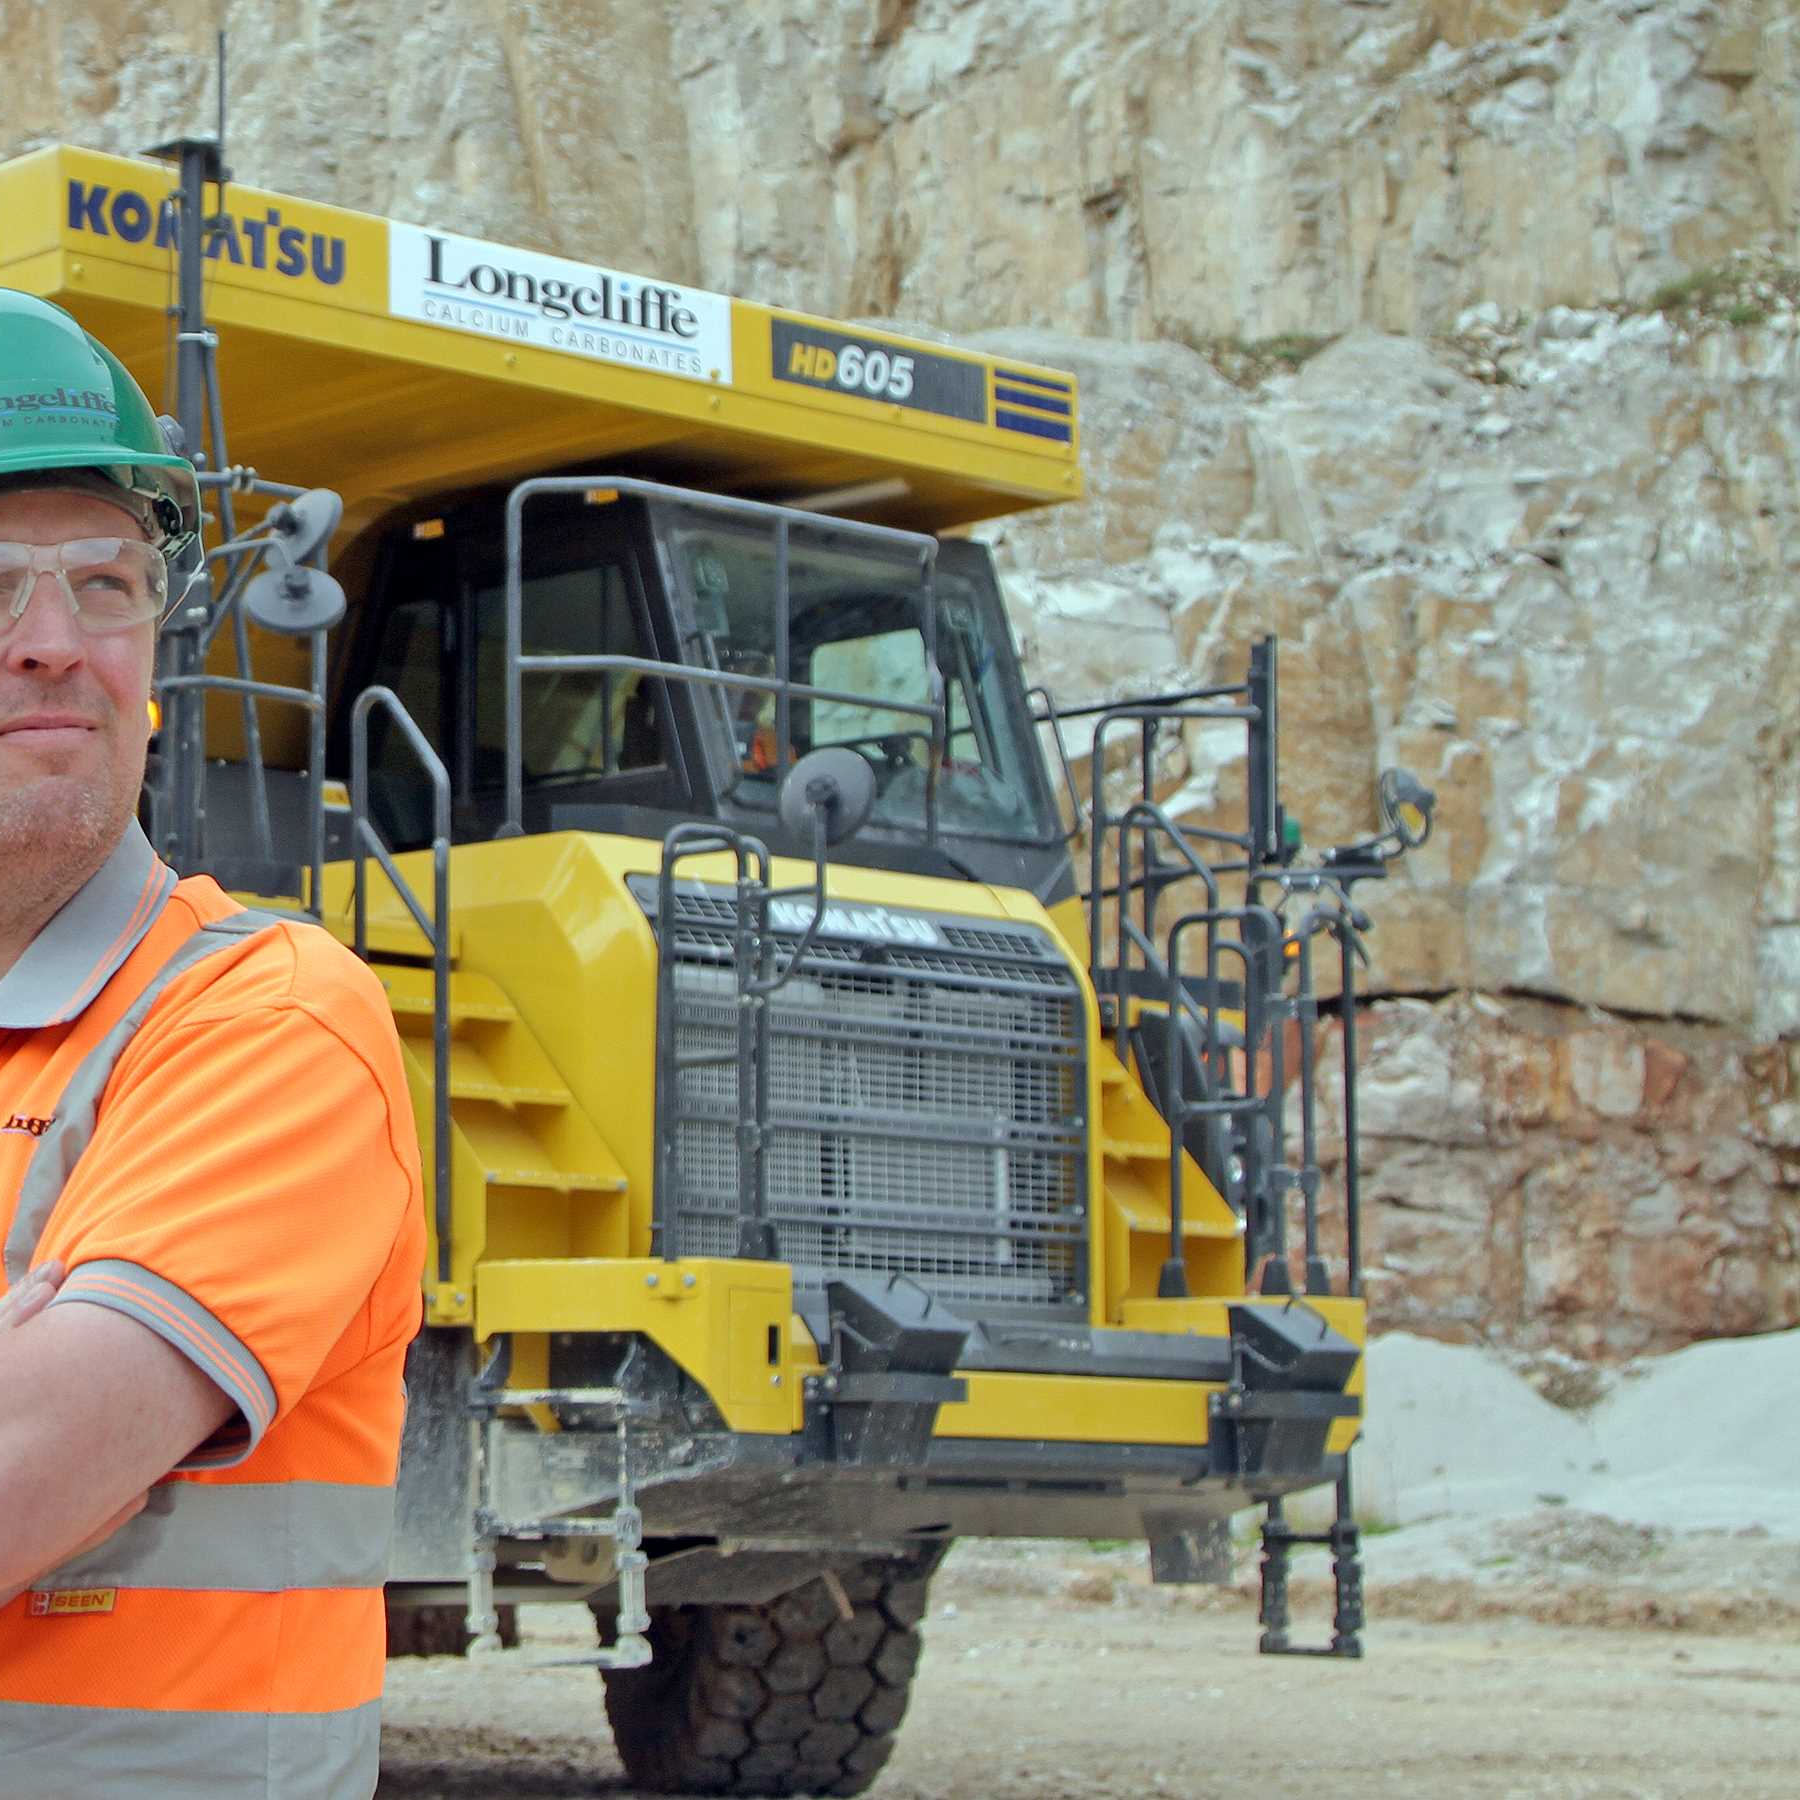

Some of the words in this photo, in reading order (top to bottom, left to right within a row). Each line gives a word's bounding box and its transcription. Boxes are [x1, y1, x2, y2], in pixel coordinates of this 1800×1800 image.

[424, 234, 700, 339] Longcliffe
[423, 298, 530, 338] CALCIUM
[550, 326, 703, 375] CARBONATES
[788, 341, 915, 400] HD605
[23, 415, 125, 433] CARBONATE
[54, 1594, 106, 1608] SEEN
